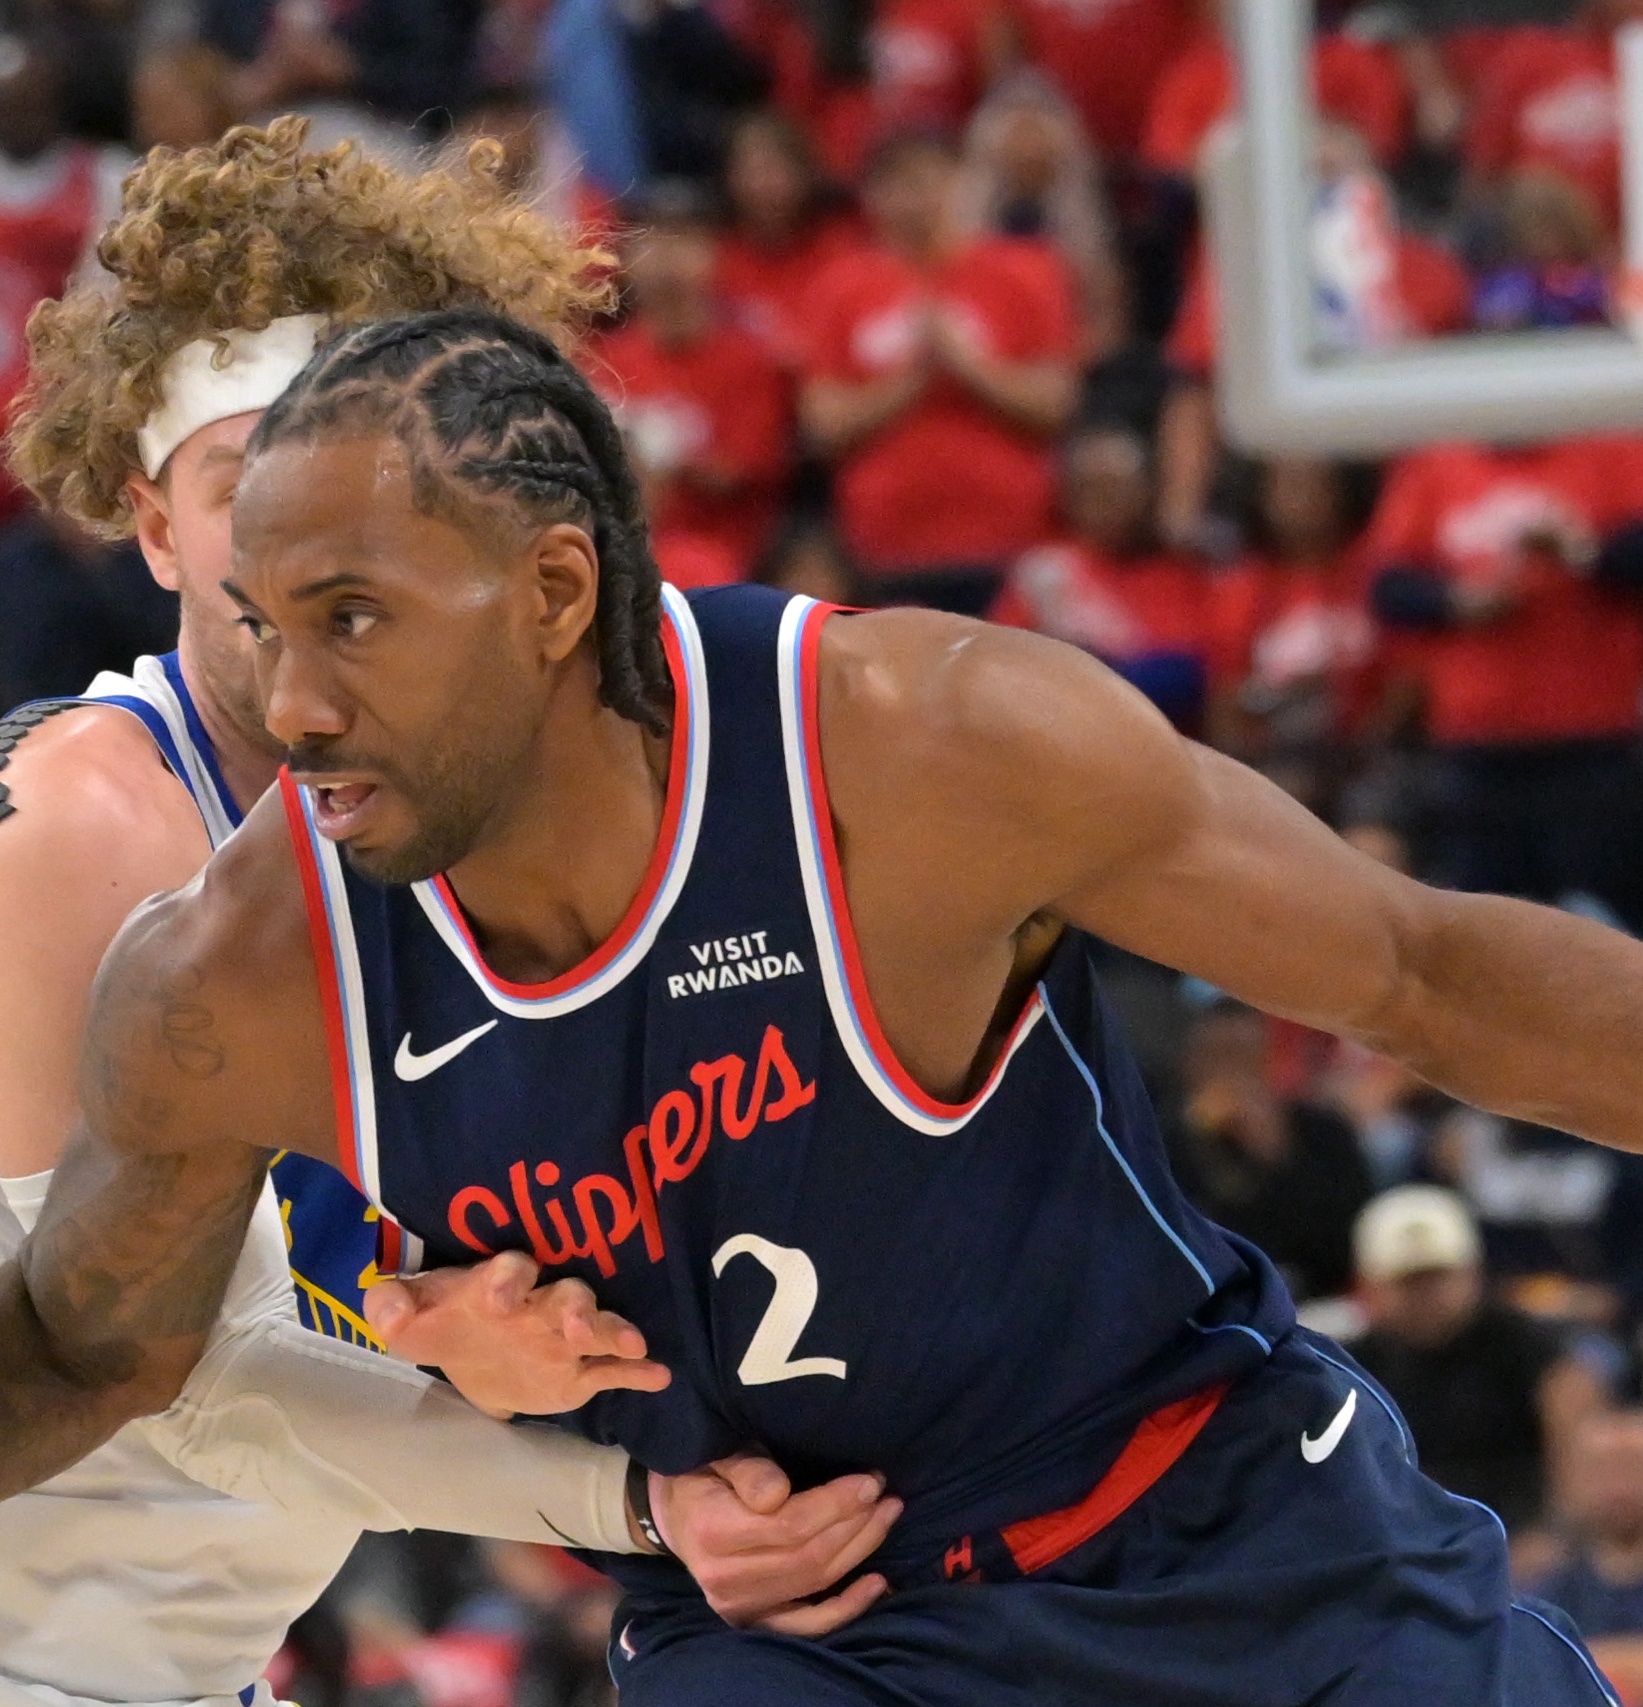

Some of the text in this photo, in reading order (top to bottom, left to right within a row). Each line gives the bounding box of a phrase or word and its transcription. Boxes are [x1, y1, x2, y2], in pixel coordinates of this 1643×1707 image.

[666, 951, 805, 999] RWANDA
[688, 930, 768, 966] VISIT
[448, 1023, 816, 1279] Clippers
[711, 1232, 846, 1386] 2
